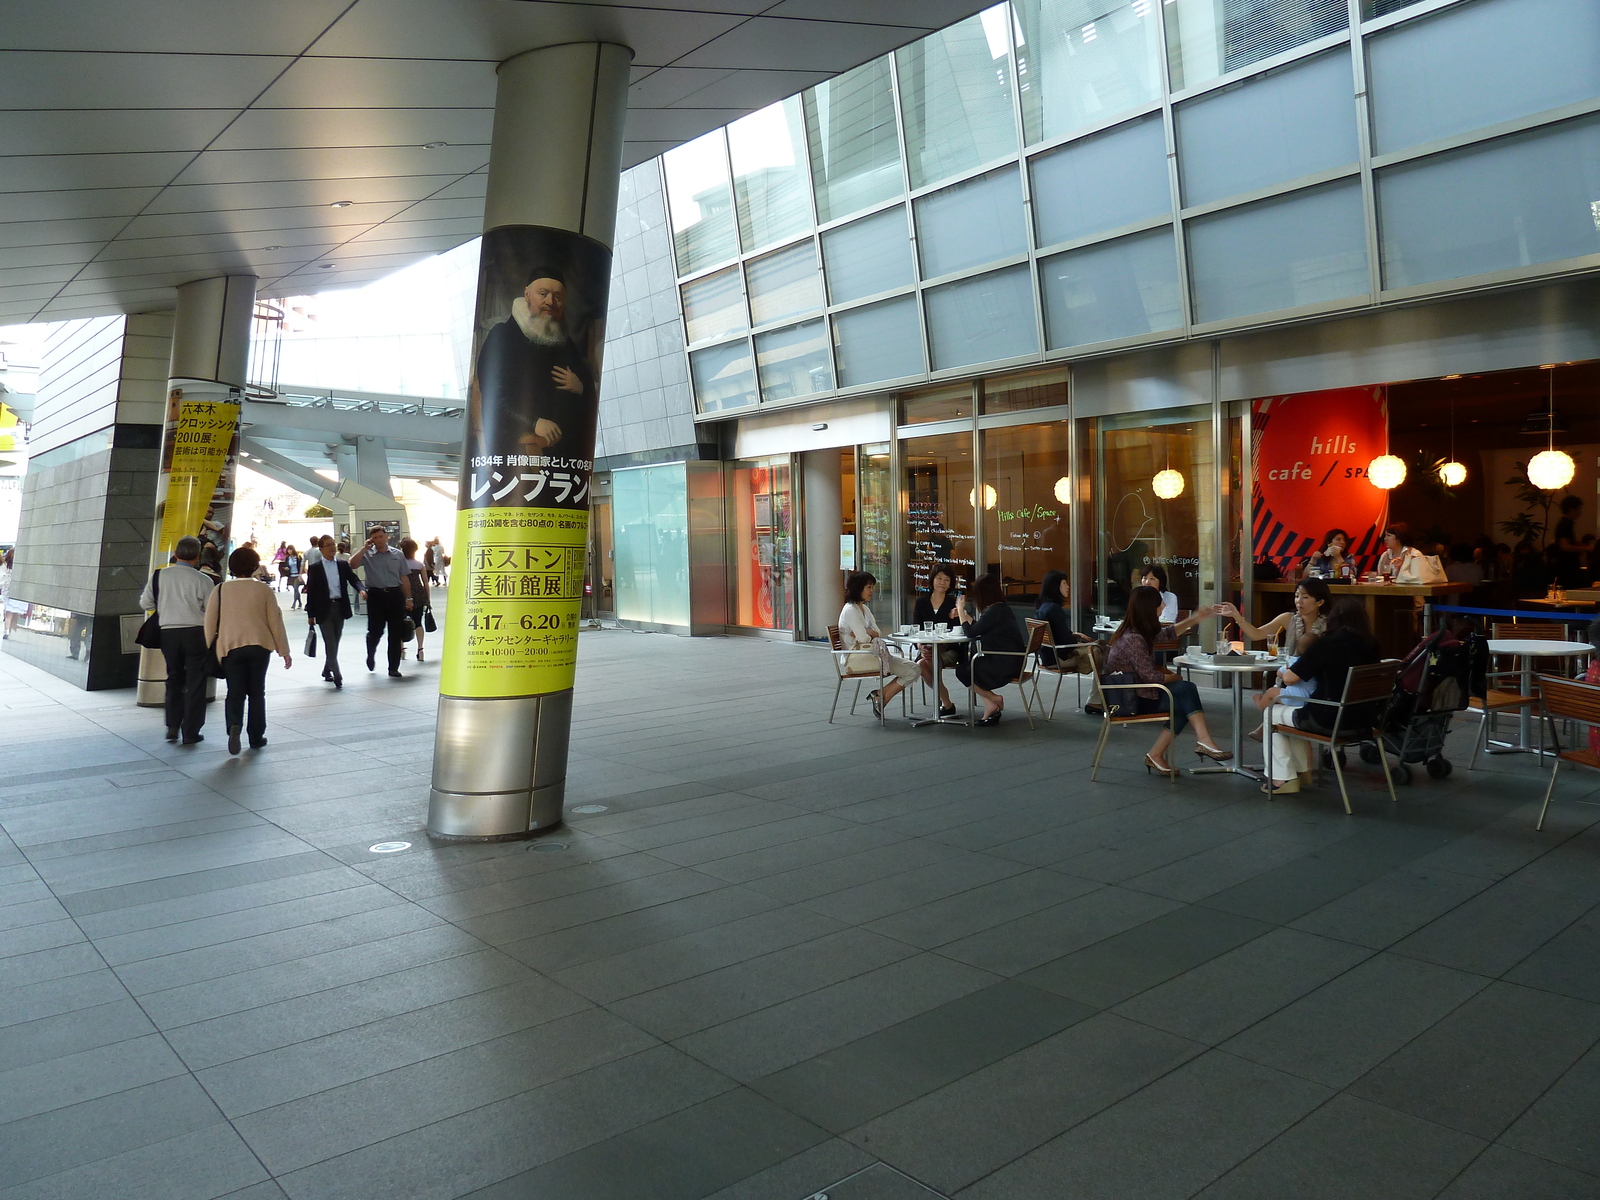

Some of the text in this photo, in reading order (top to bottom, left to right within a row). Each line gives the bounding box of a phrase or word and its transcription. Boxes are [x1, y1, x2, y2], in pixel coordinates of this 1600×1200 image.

[182, 403, 216, 415] 六本木
[179, 418, 236, 431] クロッシング
[175, 446, 227, 457] 芸術は可能か?
[1310, 436, 1356, 456] hills
[470, 455, 503, 468] 1634年
[1268, 461, 1312, 481] café
[1344, 468, 1369, 479] SPA
[474, 548, 562, 570] ボストン
[473, 575, 561, 596] 美術館展
[468, 633, 575, 646] 森アーツセンターギャラリー
